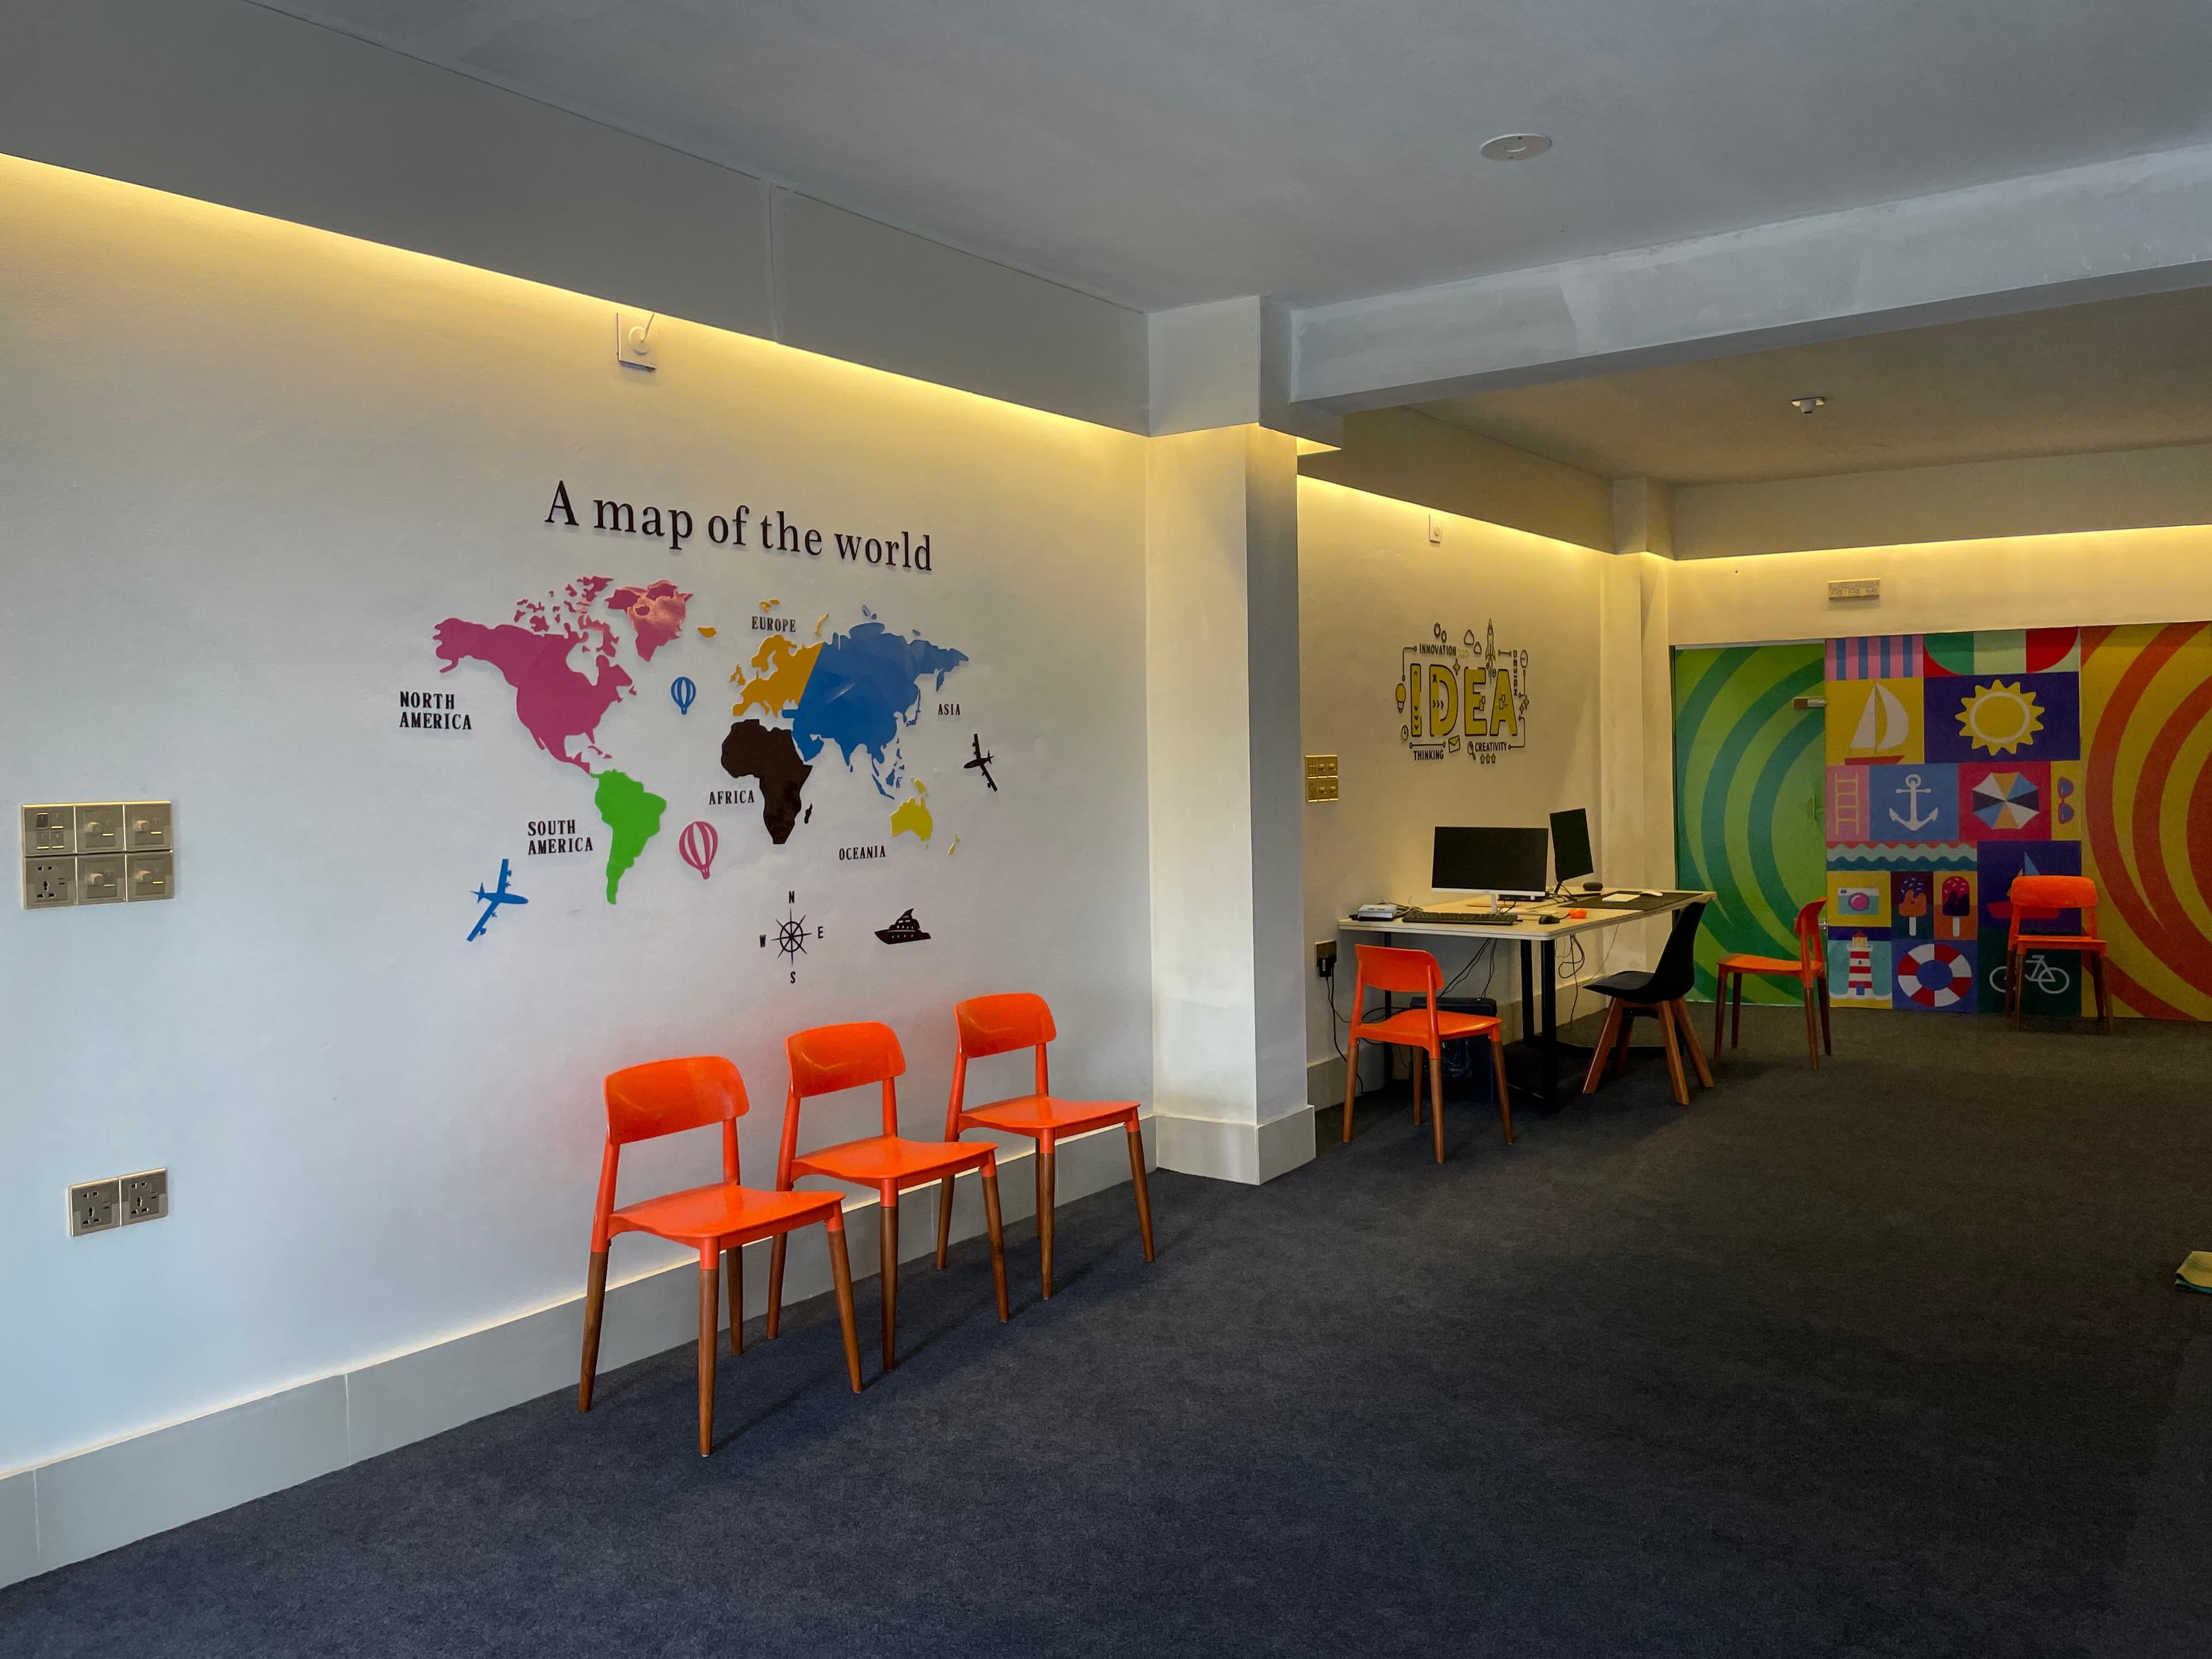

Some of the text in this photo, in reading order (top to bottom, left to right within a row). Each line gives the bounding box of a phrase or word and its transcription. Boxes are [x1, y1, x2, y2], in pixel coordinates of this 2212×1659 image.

[544, 480, 932, 571] A map of the world
[751, 616, 796, 632] EUROPE
[1419, 643, 1457, 656] INNOVATION
[399, 691, 454, 710] NORTH
[1410, 663, 1518, 737] IDEA
[937, 703, 961, 716] ASIA
[399, 712, 472, 730] AMERICA
[1475, 741, 1508, 752] CREATIVITY
[1413, 751, 1444, 761] THINKING
[709, 790, 755, 805] AFRICA
[528, 819, 576, 836] SOUTH
[528, 837, 594, 855] AMERICA
[839, 845, 886, 861] OCEANIA
[789, 891, 795, 904] N
[817, 926, 824, 939] E
[759, 934, 766, 948] W
[790, 971, 796, 984] S
